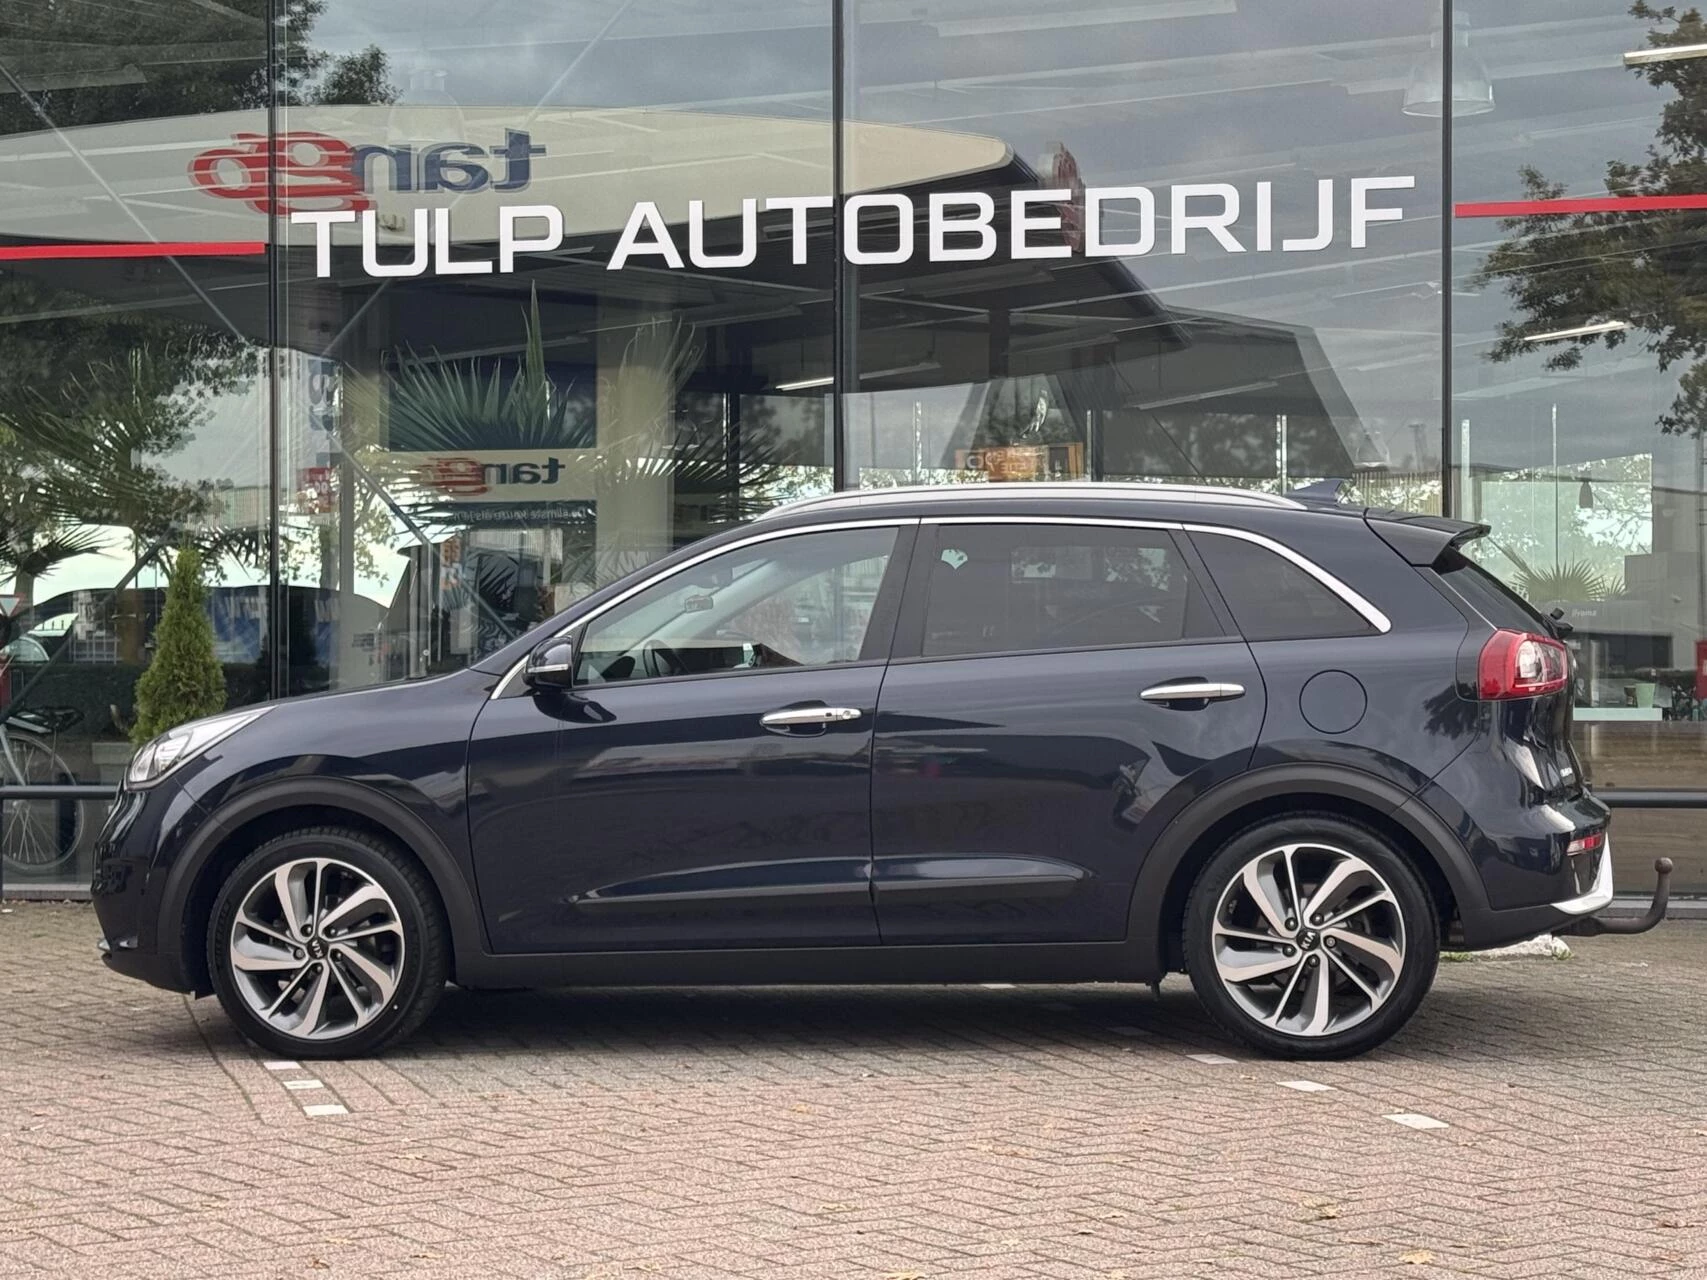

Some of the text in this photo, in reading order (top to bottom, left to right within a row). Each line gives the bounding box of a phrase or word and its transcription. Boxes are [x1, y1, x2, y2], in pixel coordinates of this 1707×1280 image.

[291, 175, 1416, 278] TULP AUTOBEDRIJF
[1301, 931, 1317, 950] KIA
